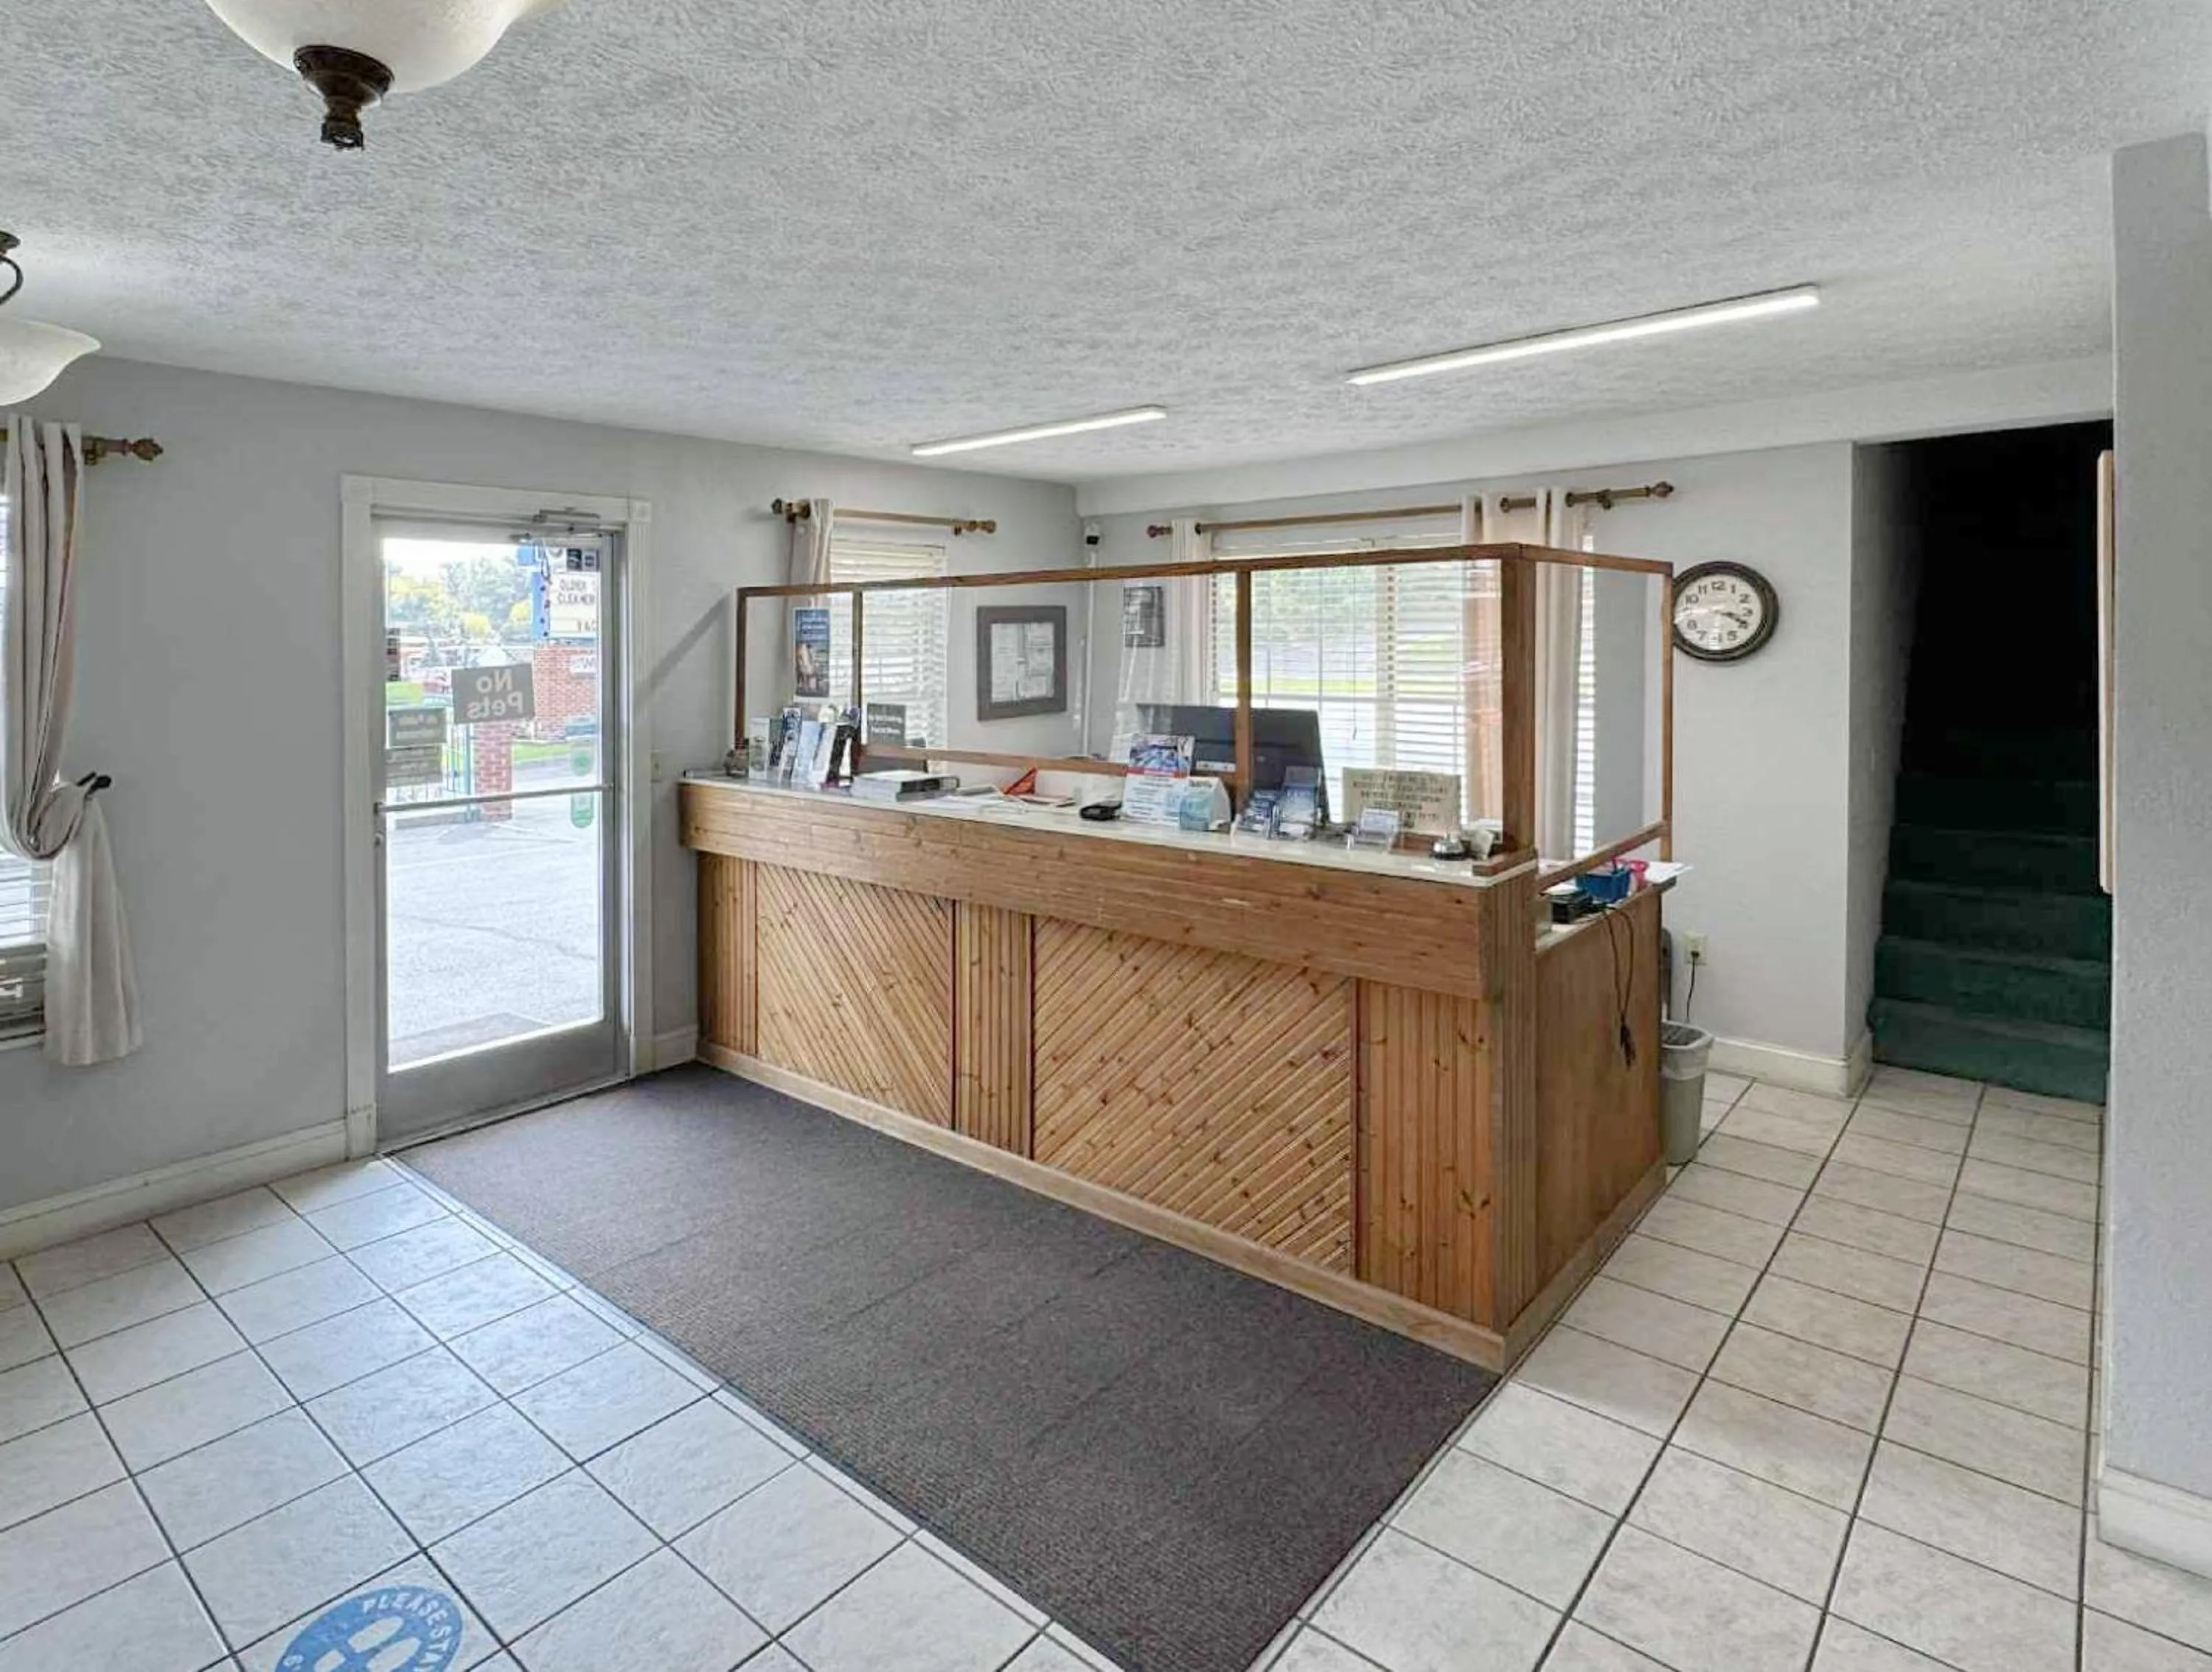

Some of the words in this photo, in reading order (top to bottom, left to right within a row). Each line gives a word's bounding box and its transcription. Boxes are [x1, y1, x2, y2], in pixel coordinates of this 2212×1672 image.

[1698, 584, 1708, 594] 11
[1711, 580, 1725, 591] 12
[1685, 594, 1699, 604] 10
[1739, 594, 1750, 604] 2
[1696, 630, 1707, 641] 7
[1727, 631, 1738, 641] 5
[362, 1592, 448, 1627] PLEASE
